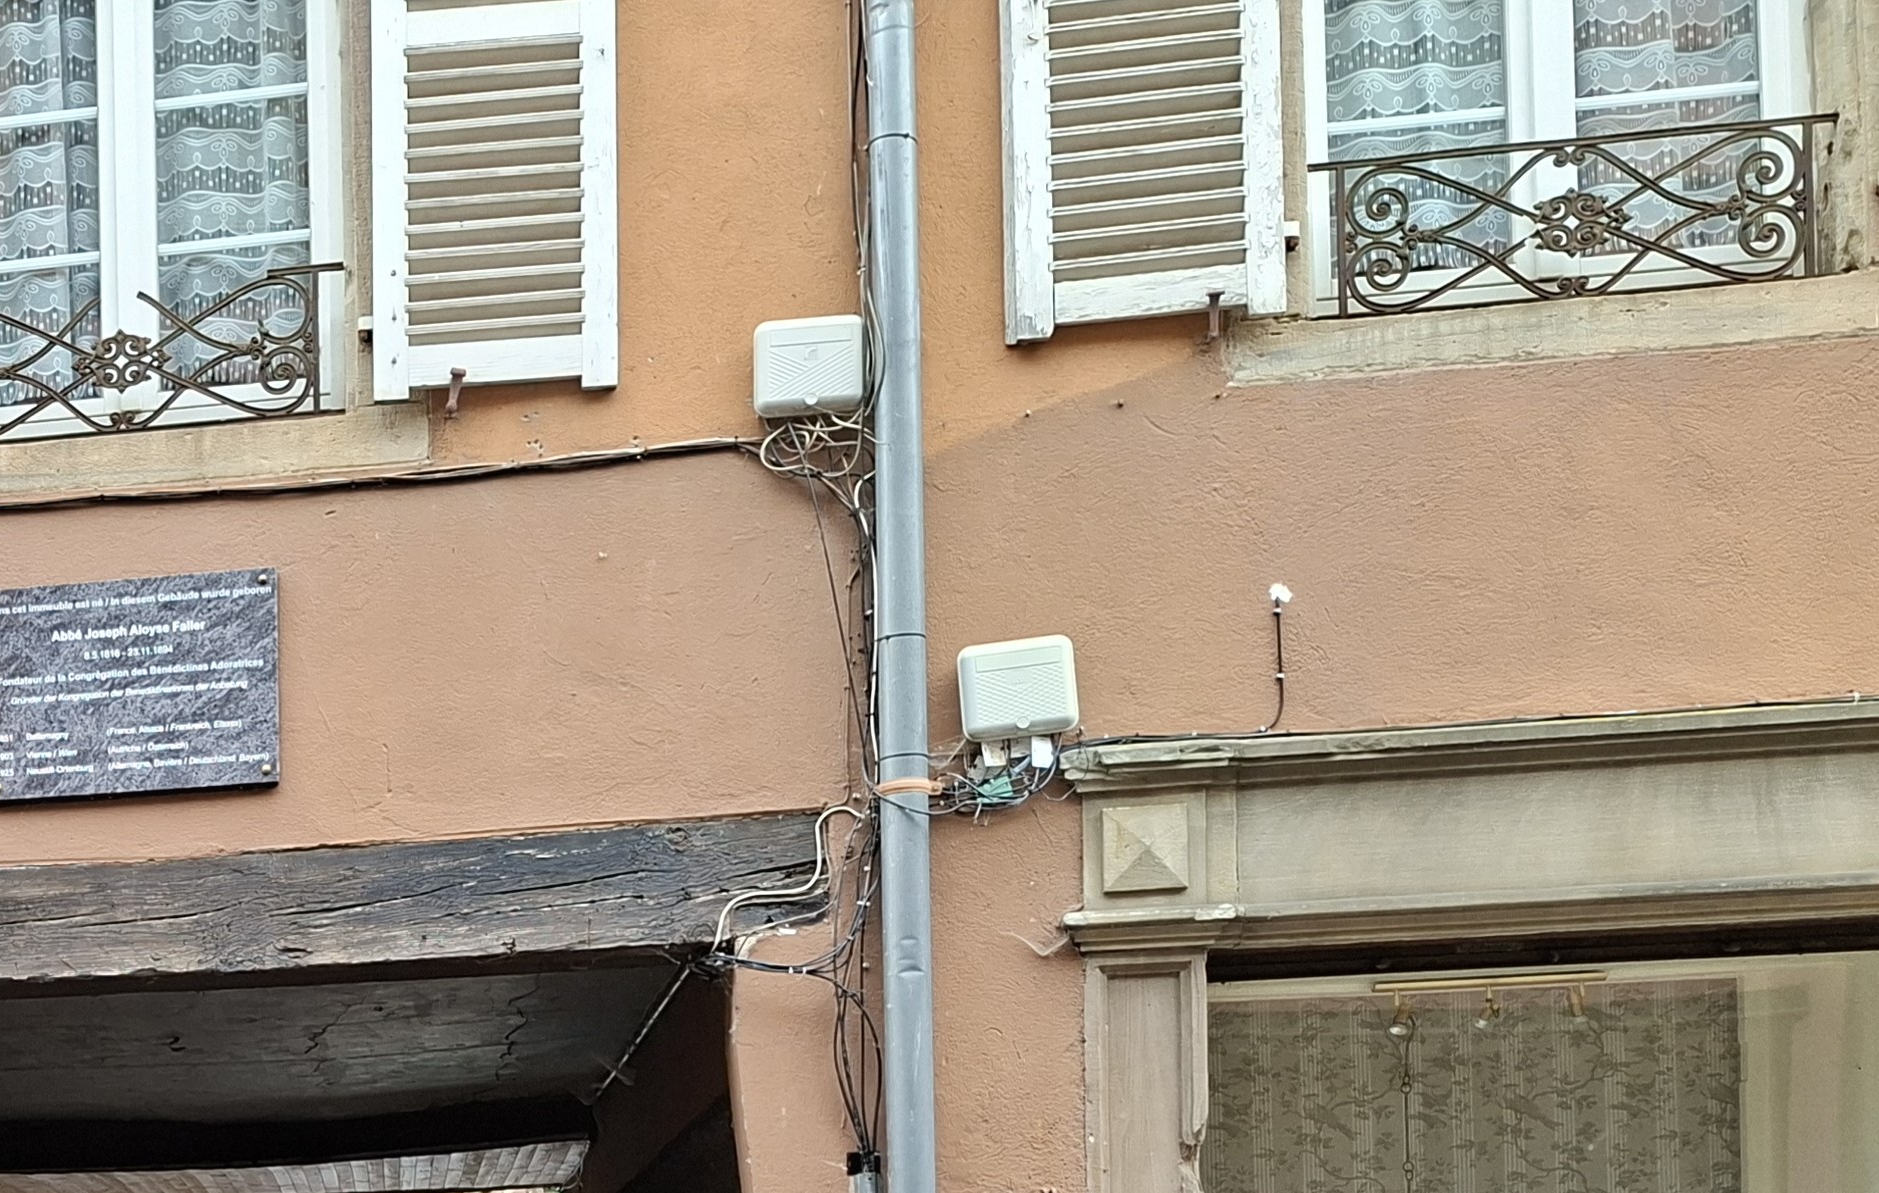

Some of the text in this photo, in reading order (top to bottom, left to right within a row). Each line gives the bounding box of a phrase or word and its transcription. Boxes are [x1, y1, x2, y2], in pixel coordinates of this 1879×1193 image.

[12, 605, 27, 614] cet
[75, 599, 90, 609] est
[91, 598, 102, 608] né
[122, 594, 156, 605] diesem
[157, 591, 200, 602] Gebäude
[201, 588, 231, 599] wurde
[232, 586, 272, 598] geboren
[51, 620, 206, 642] Abbé Joseph Aloyse Faller
[44, 674, 56, 683] de
[57, 673, 66, 682] la
[131, 667, 148, 677] des
[149, 662, 209, 675] Bénédictines
[210, 658, 264, 671] Adoratrices
[57, 691, 110, 702] Kongregation
